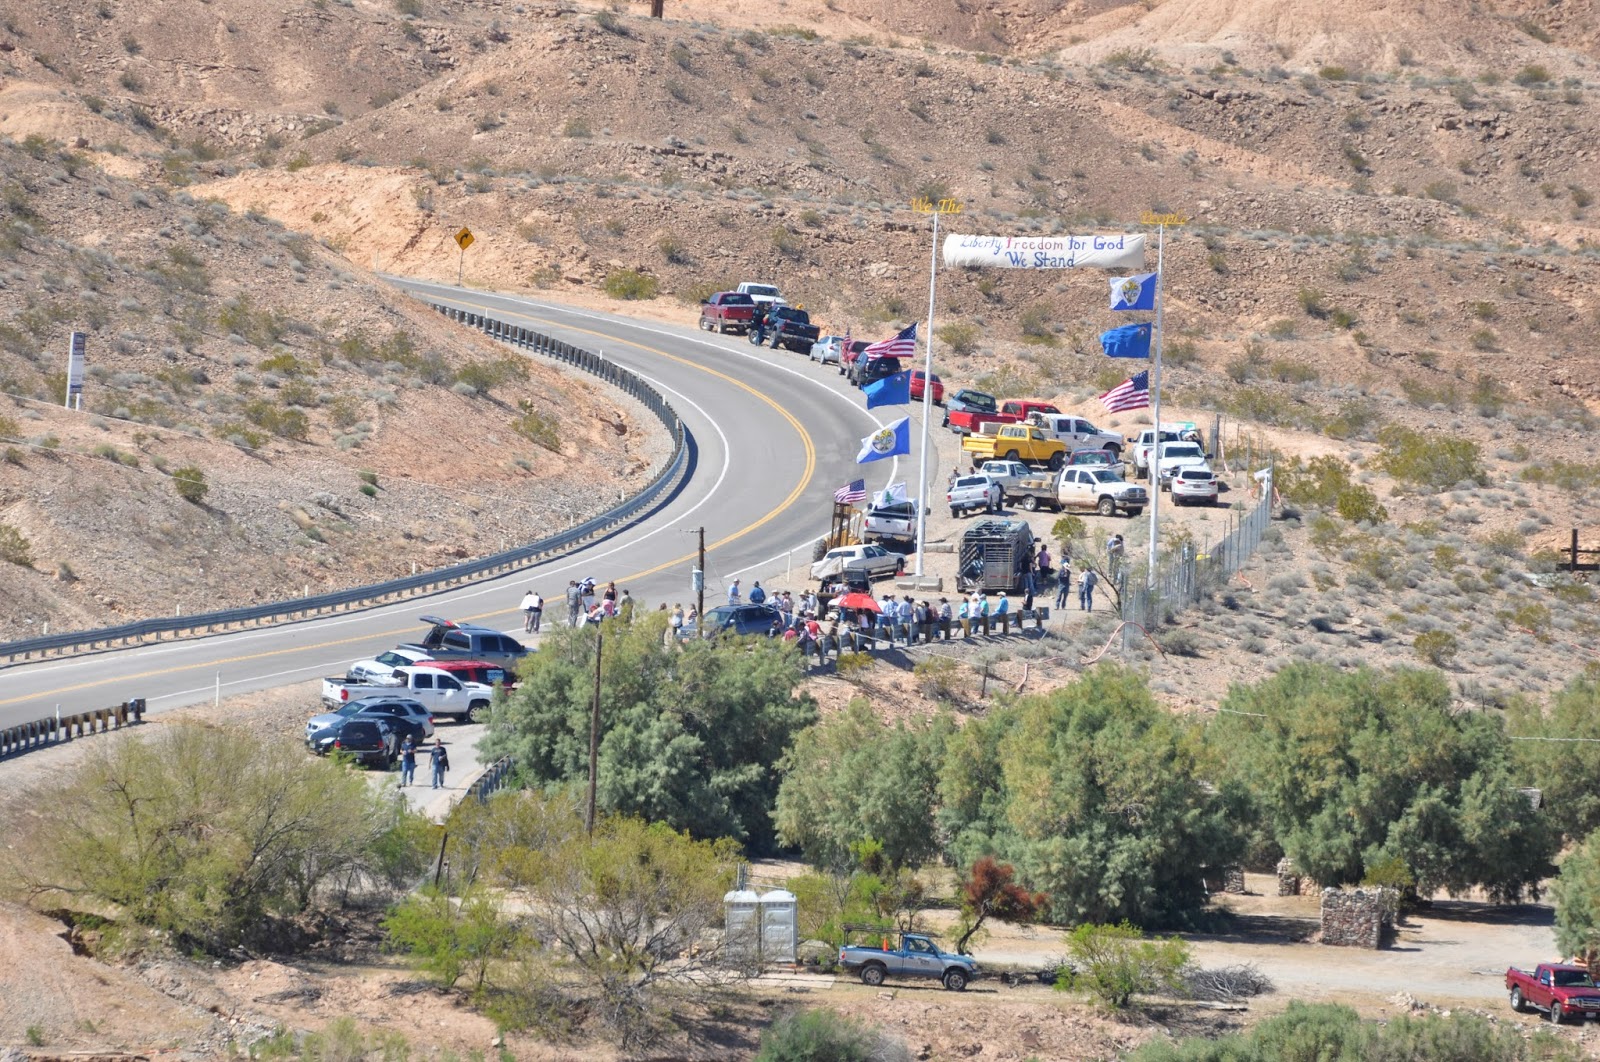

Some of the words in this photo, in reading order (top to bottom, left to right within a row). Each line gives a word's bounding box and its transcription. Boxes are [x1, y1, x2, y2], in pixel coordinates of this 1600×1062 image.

[910, 196, 933, 212] We
[937, 197, 964, 213] The
[1093, 235, 1124, 250] God
[1004, 251, 1027, 267] We
[1034, 251, 1075, 267] Stand
